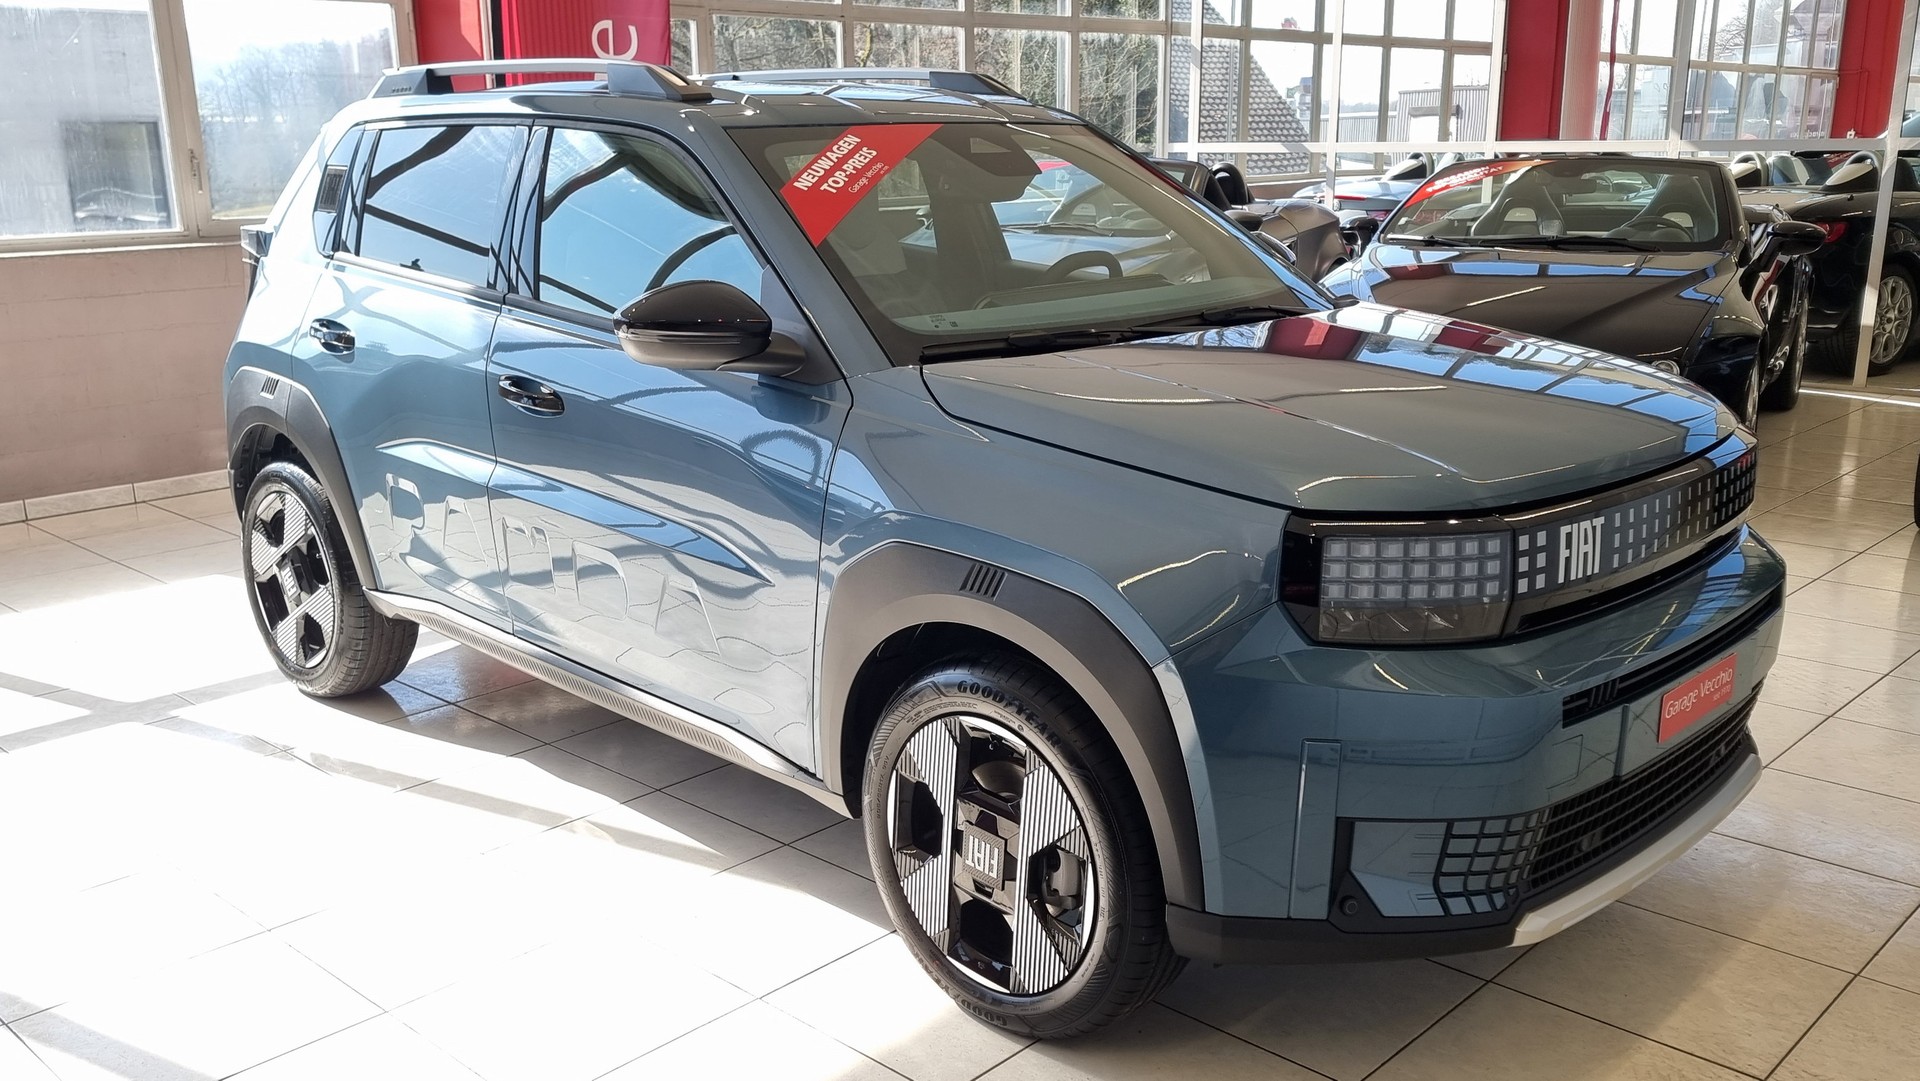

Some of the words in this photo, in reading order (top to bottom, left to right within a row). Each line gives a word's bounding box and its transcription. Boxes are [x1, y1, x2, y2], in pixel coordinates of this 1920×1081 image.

[793, 134, 861, 191] NEUWAGEN
[820, 146, 878, 194] TOP-PREIS
[848, 176, 869, 193] Garage
[863, 162, 884, 179] Vecchio
[1558, 516, 1605, 584] FIAT
[1665, 689, 1699, 719] Garage
[1700, 667, 1733, 697] Vecchio
[965, 834, 999, 879] FIAT
